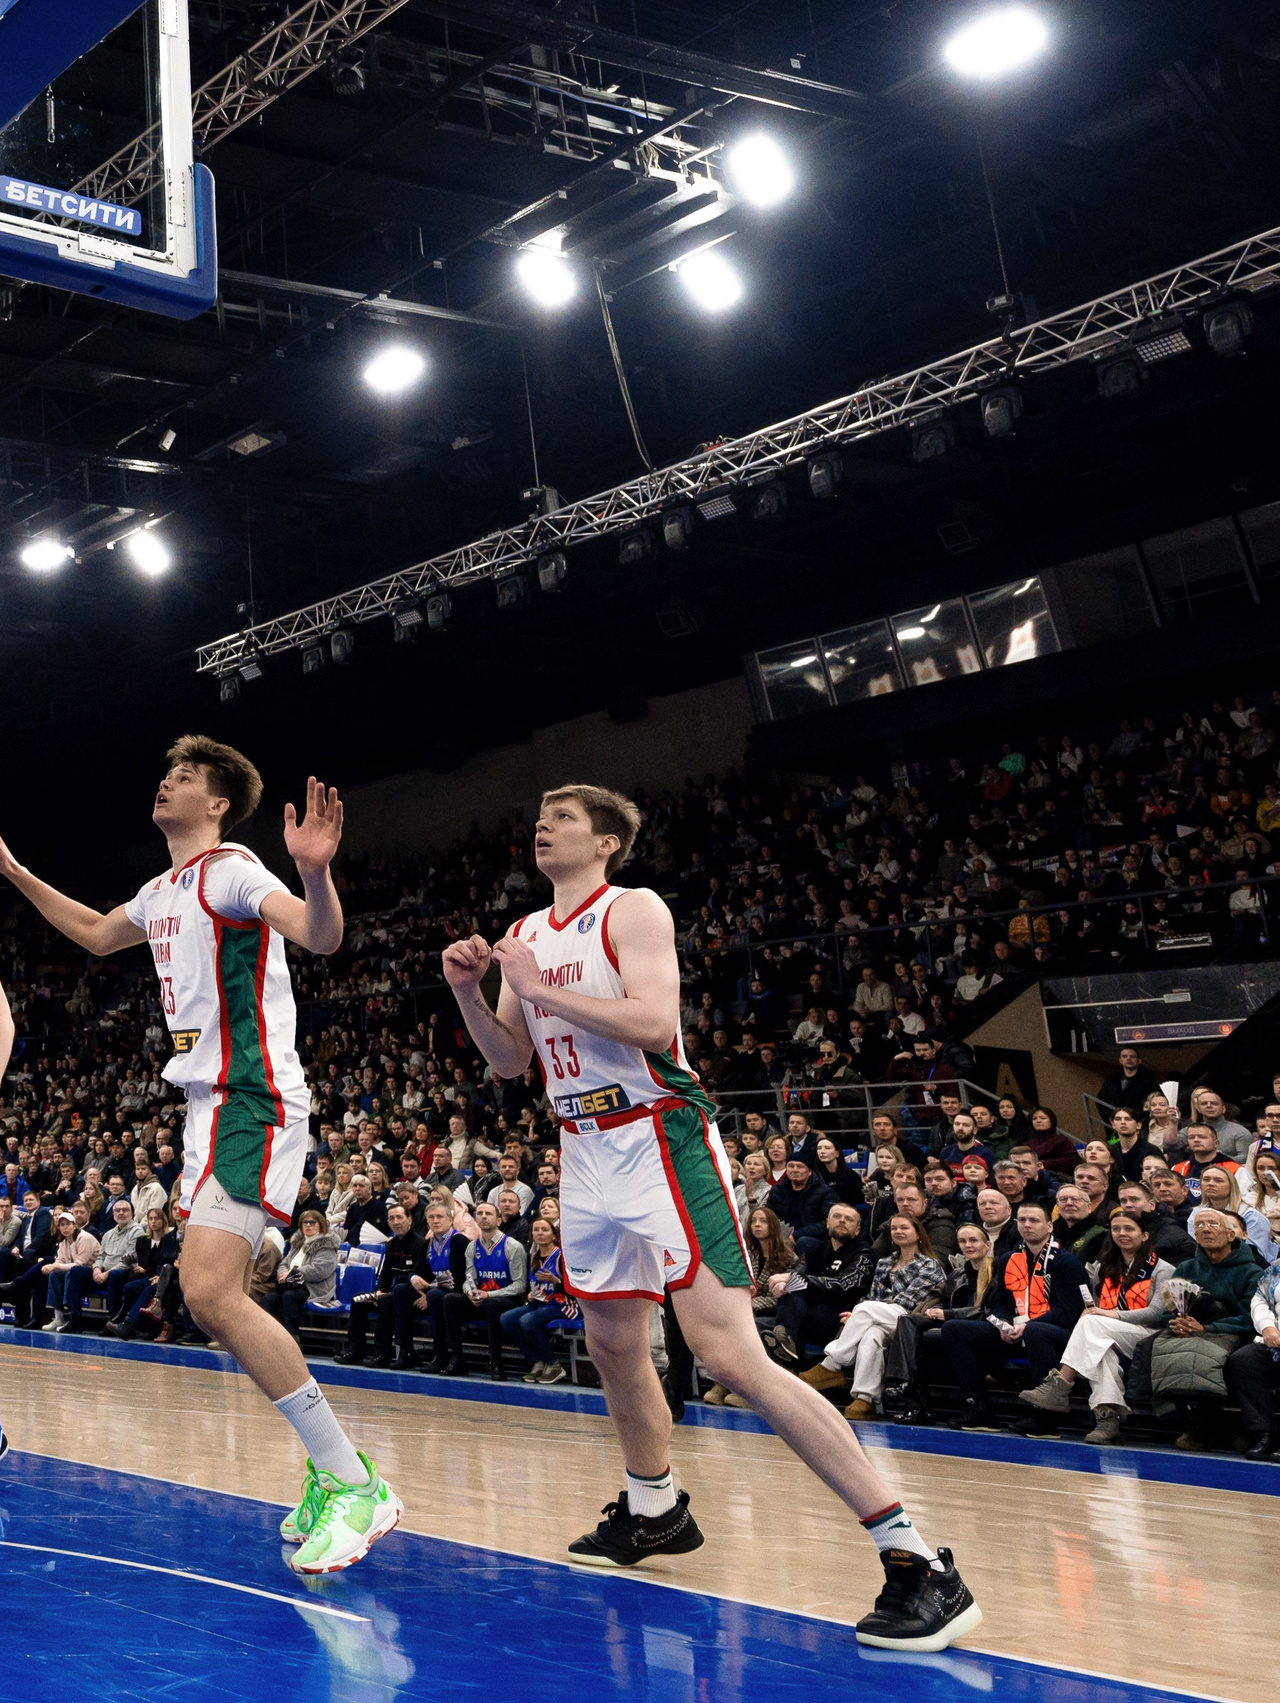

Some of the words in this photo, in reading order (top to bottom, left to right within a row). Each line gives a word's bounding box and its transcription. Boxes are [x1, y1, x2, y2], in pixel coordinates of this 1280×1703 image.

[5, 180, 135, 230] БЕТСИТИ
[1167, 1026, 1196, 1035] ВЫХОД
[545, 1034, 581, 1080] 33
[579, 1120, 596, 1131] BCLK
[478, 1270, 507, 1279] PARMA
